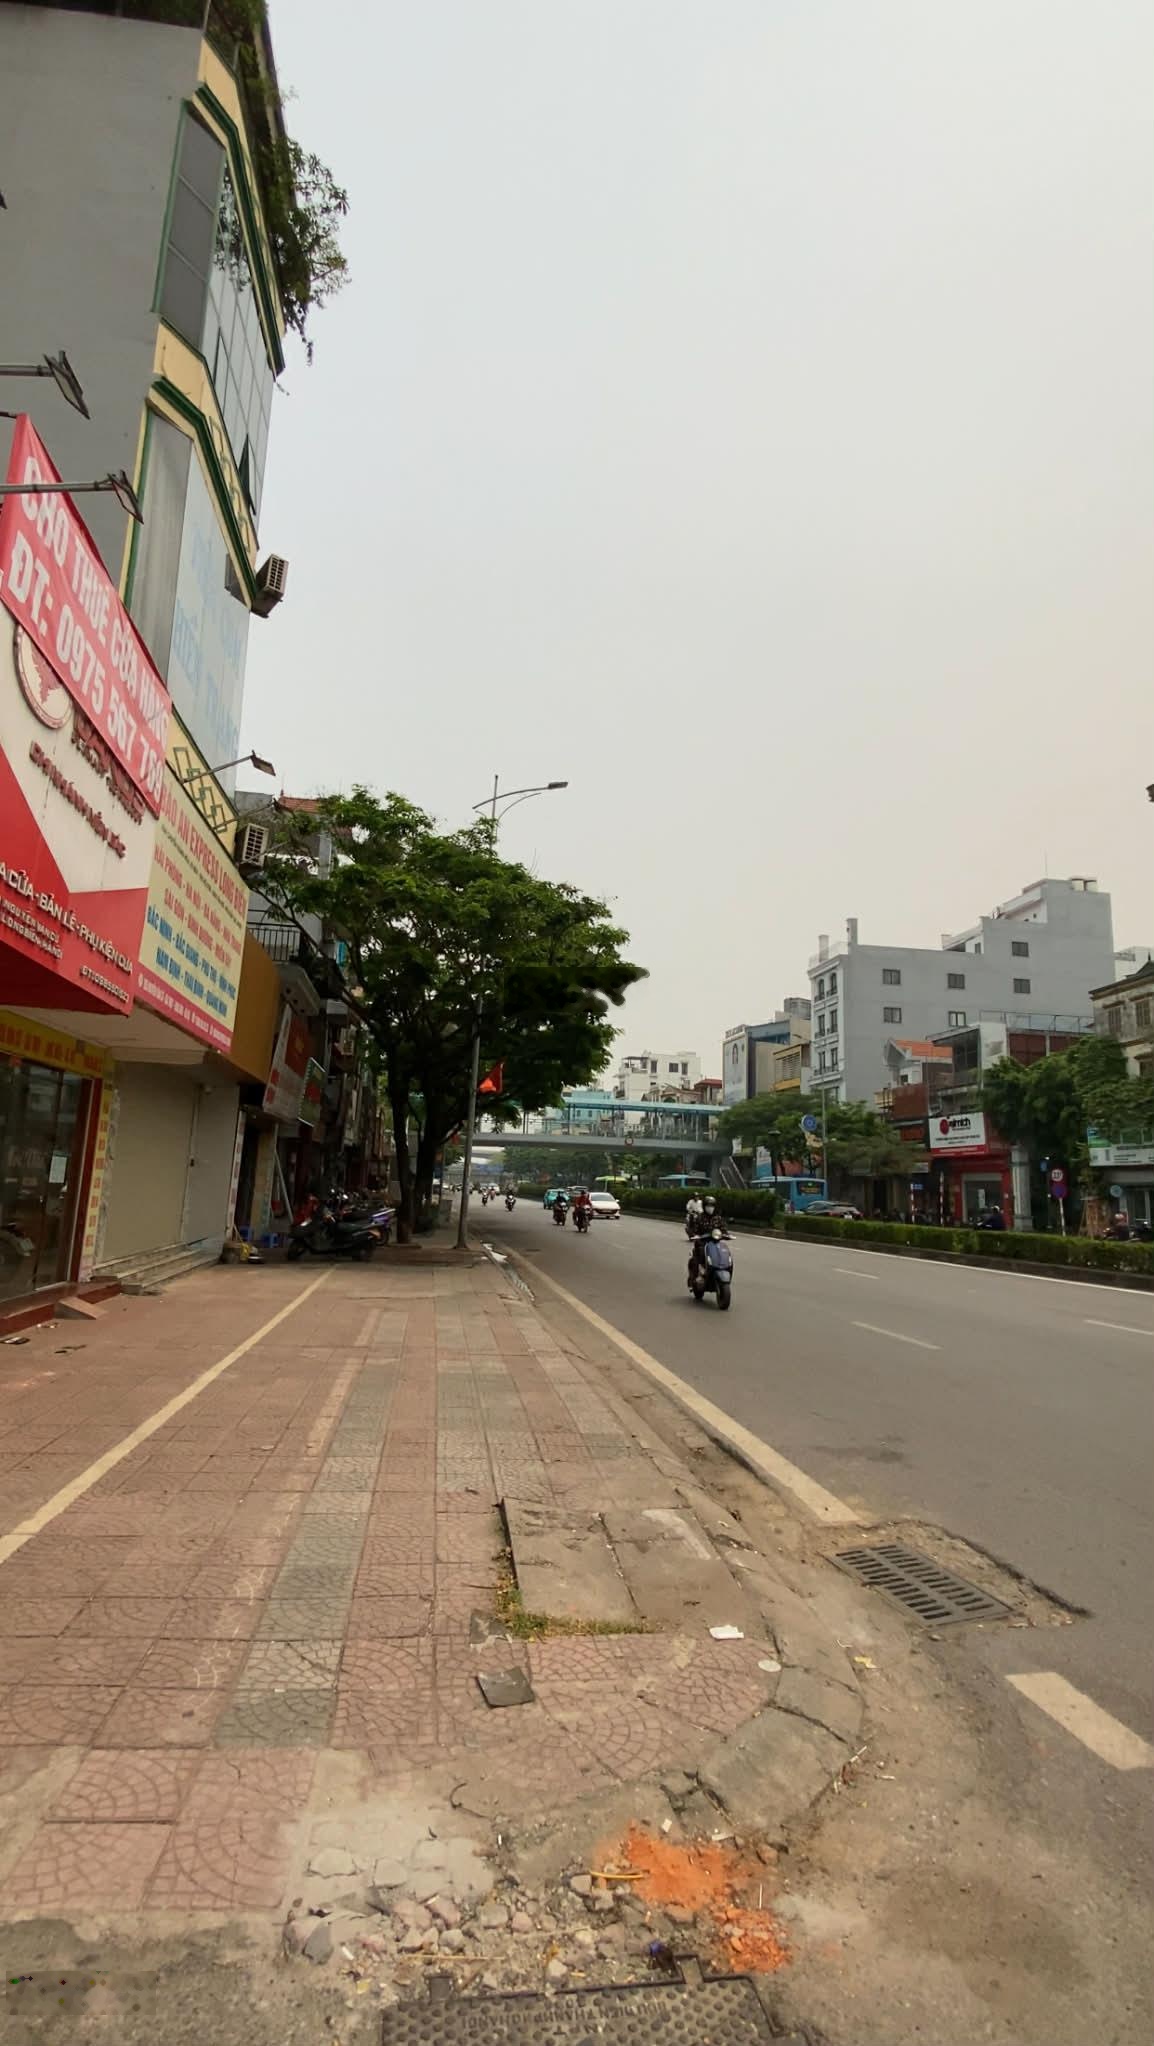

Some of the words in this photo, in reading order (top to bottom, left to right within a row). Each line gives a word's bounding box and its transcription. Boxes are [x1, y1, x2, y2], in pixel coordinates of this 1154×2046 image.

[22, 456, 70, 567] CHO
[7, 530, 51, 637] ĐT:
[56, 603, 105, 715] 0975
[107, 684, 137, 762] 567
[8, 868, 34, 901] CỬA
[39, 892, 63, 925] BẢN
[188, 823, 220, 885] EXPRESS
